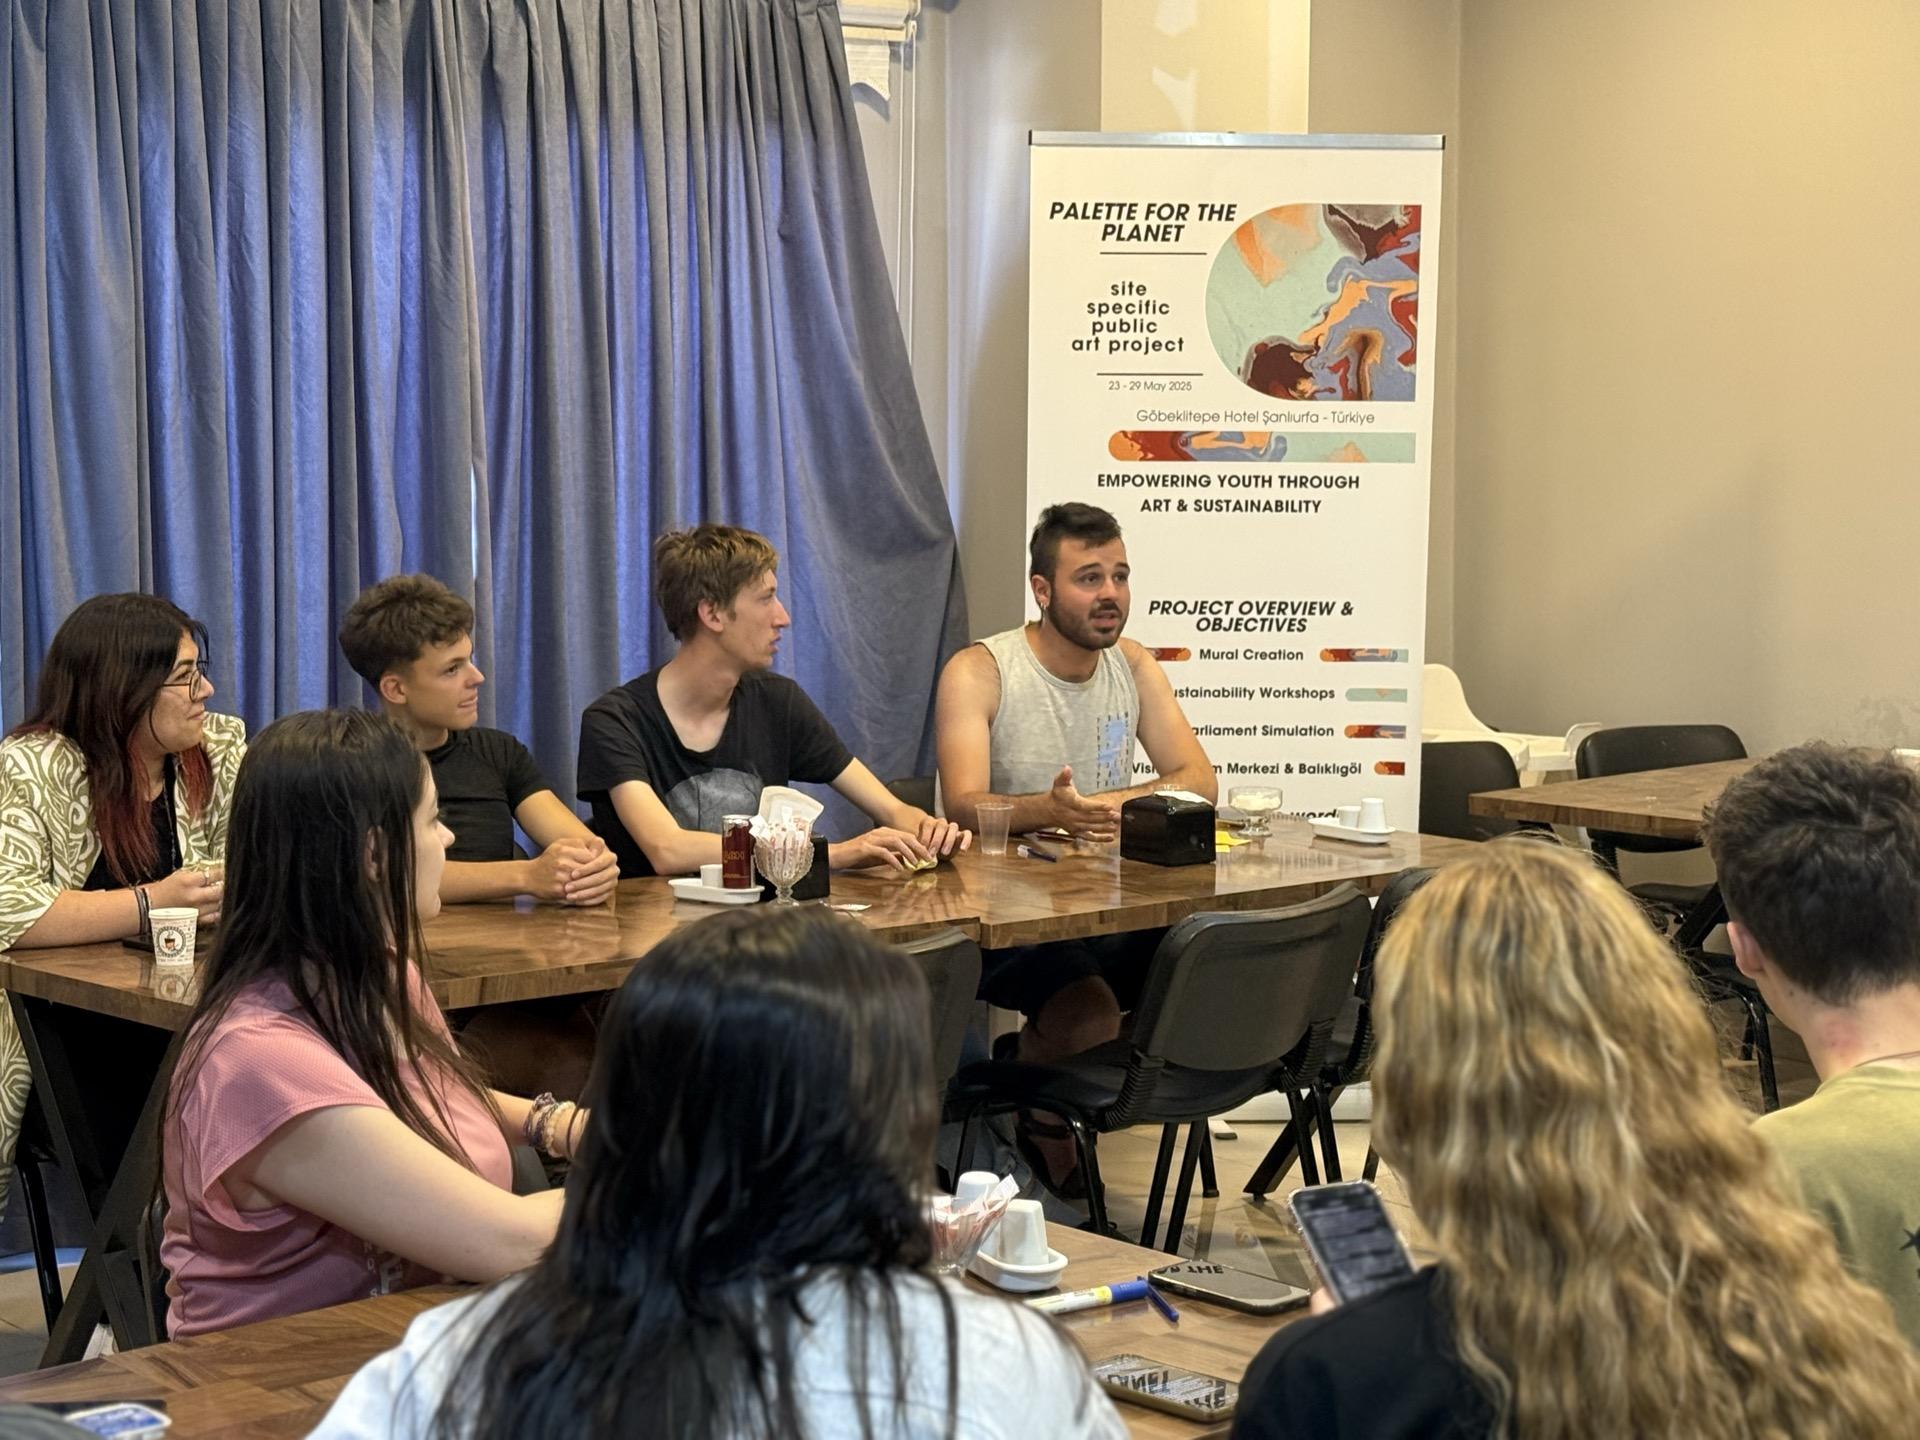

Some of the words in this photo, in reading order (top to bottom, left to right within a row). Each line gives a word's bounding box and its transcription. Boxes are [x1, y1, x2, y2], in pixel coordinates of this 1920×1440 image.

[1049, 201, 1139, 221] PALETTE
[1144, 202, 1190, 222] FOR
[1197, 203, 1238, 222] THE
[1101, 223, 1186, 242] PLANET
[1110, 280, 1147, 297] site
[1087, 299, 1170, 318] specific
[1091, 318, 1158, 335] public
[1071, 336, 1100, 352] art
[1108, 336, 1184, 356] project
[1108, 380, 1121, 391] 23
[1129, 380, 1142, 391] 29
[1143, 380, 1166, 394] May
[1168, 381, 1193, 392] 2025
[1136, 408, 1221, 425] Göbeklitepe
[1224, 410, 1259, 423] Hotel
[1262, 410, 1320, 426] Şanlıurfa
[1331, 411, 1376, 426] Türkiye
[1097, 474, 1212, 488] EMPOWERING
[1217, 474, 1273, 489] YOUTH
[1278, 475, 1360, 489] THROUGH
[1140, 498, 1172, 513] ART
[1176, 498, 1188, 513] &
[1193, 498, 1322, 514] SUSTAINABILITY
[1148, 600, 1234, 616] PROJECT
[1238, 600, 1336, 616] OVERVIEW
[1340, 601, 1354, 616] &
[1196, 617, 1308, 633] OBJECTIVES
[1199, 648, 1239, 661] Mural
[1242, 648, 1304, 662] Creation
[1174, 686, 1255, 701] stainability
[1259, 687, 1336, 701] Workshops
[1192, 724, 1257, 737] arliament
[1261, 724, 1335, 737] Simulation
[1227, 762, 1280, 775] Merkezi
[1284, 763, 1294, 775] &
[1298, 762, 1362, 779] Balıklıgöl
